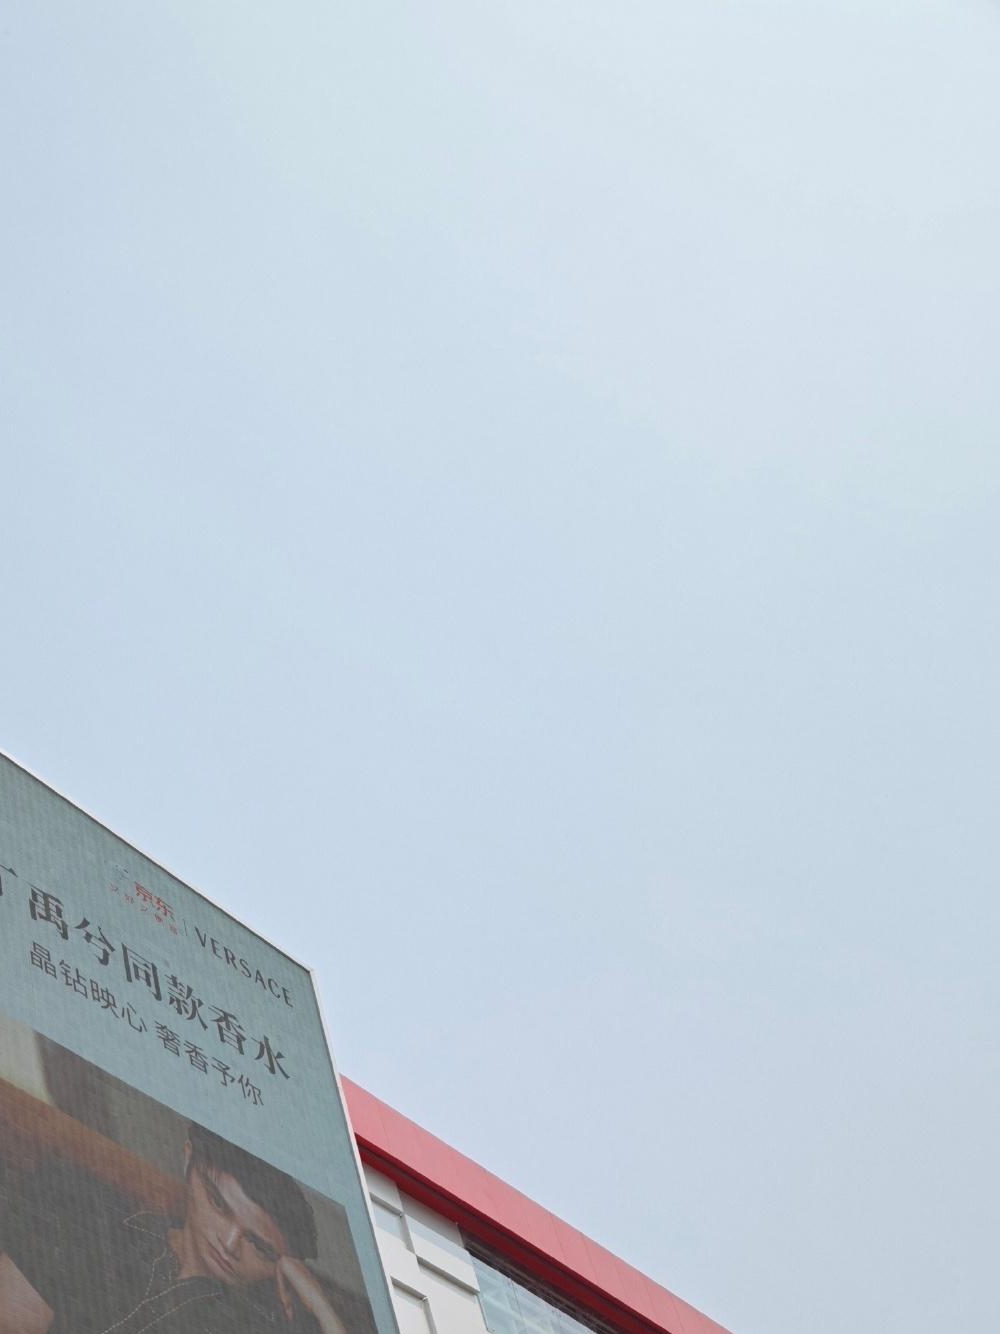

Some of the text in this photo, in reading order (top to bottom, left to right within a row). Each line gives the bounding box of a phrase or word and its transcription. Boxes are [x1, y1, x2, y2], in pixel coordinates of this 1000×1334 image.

[135, 881, 175, 921] 京东
[194, 926, 294, 1009] VERSACE
[29, 941, 264, 1107] 晶钻映心 奢香予你
